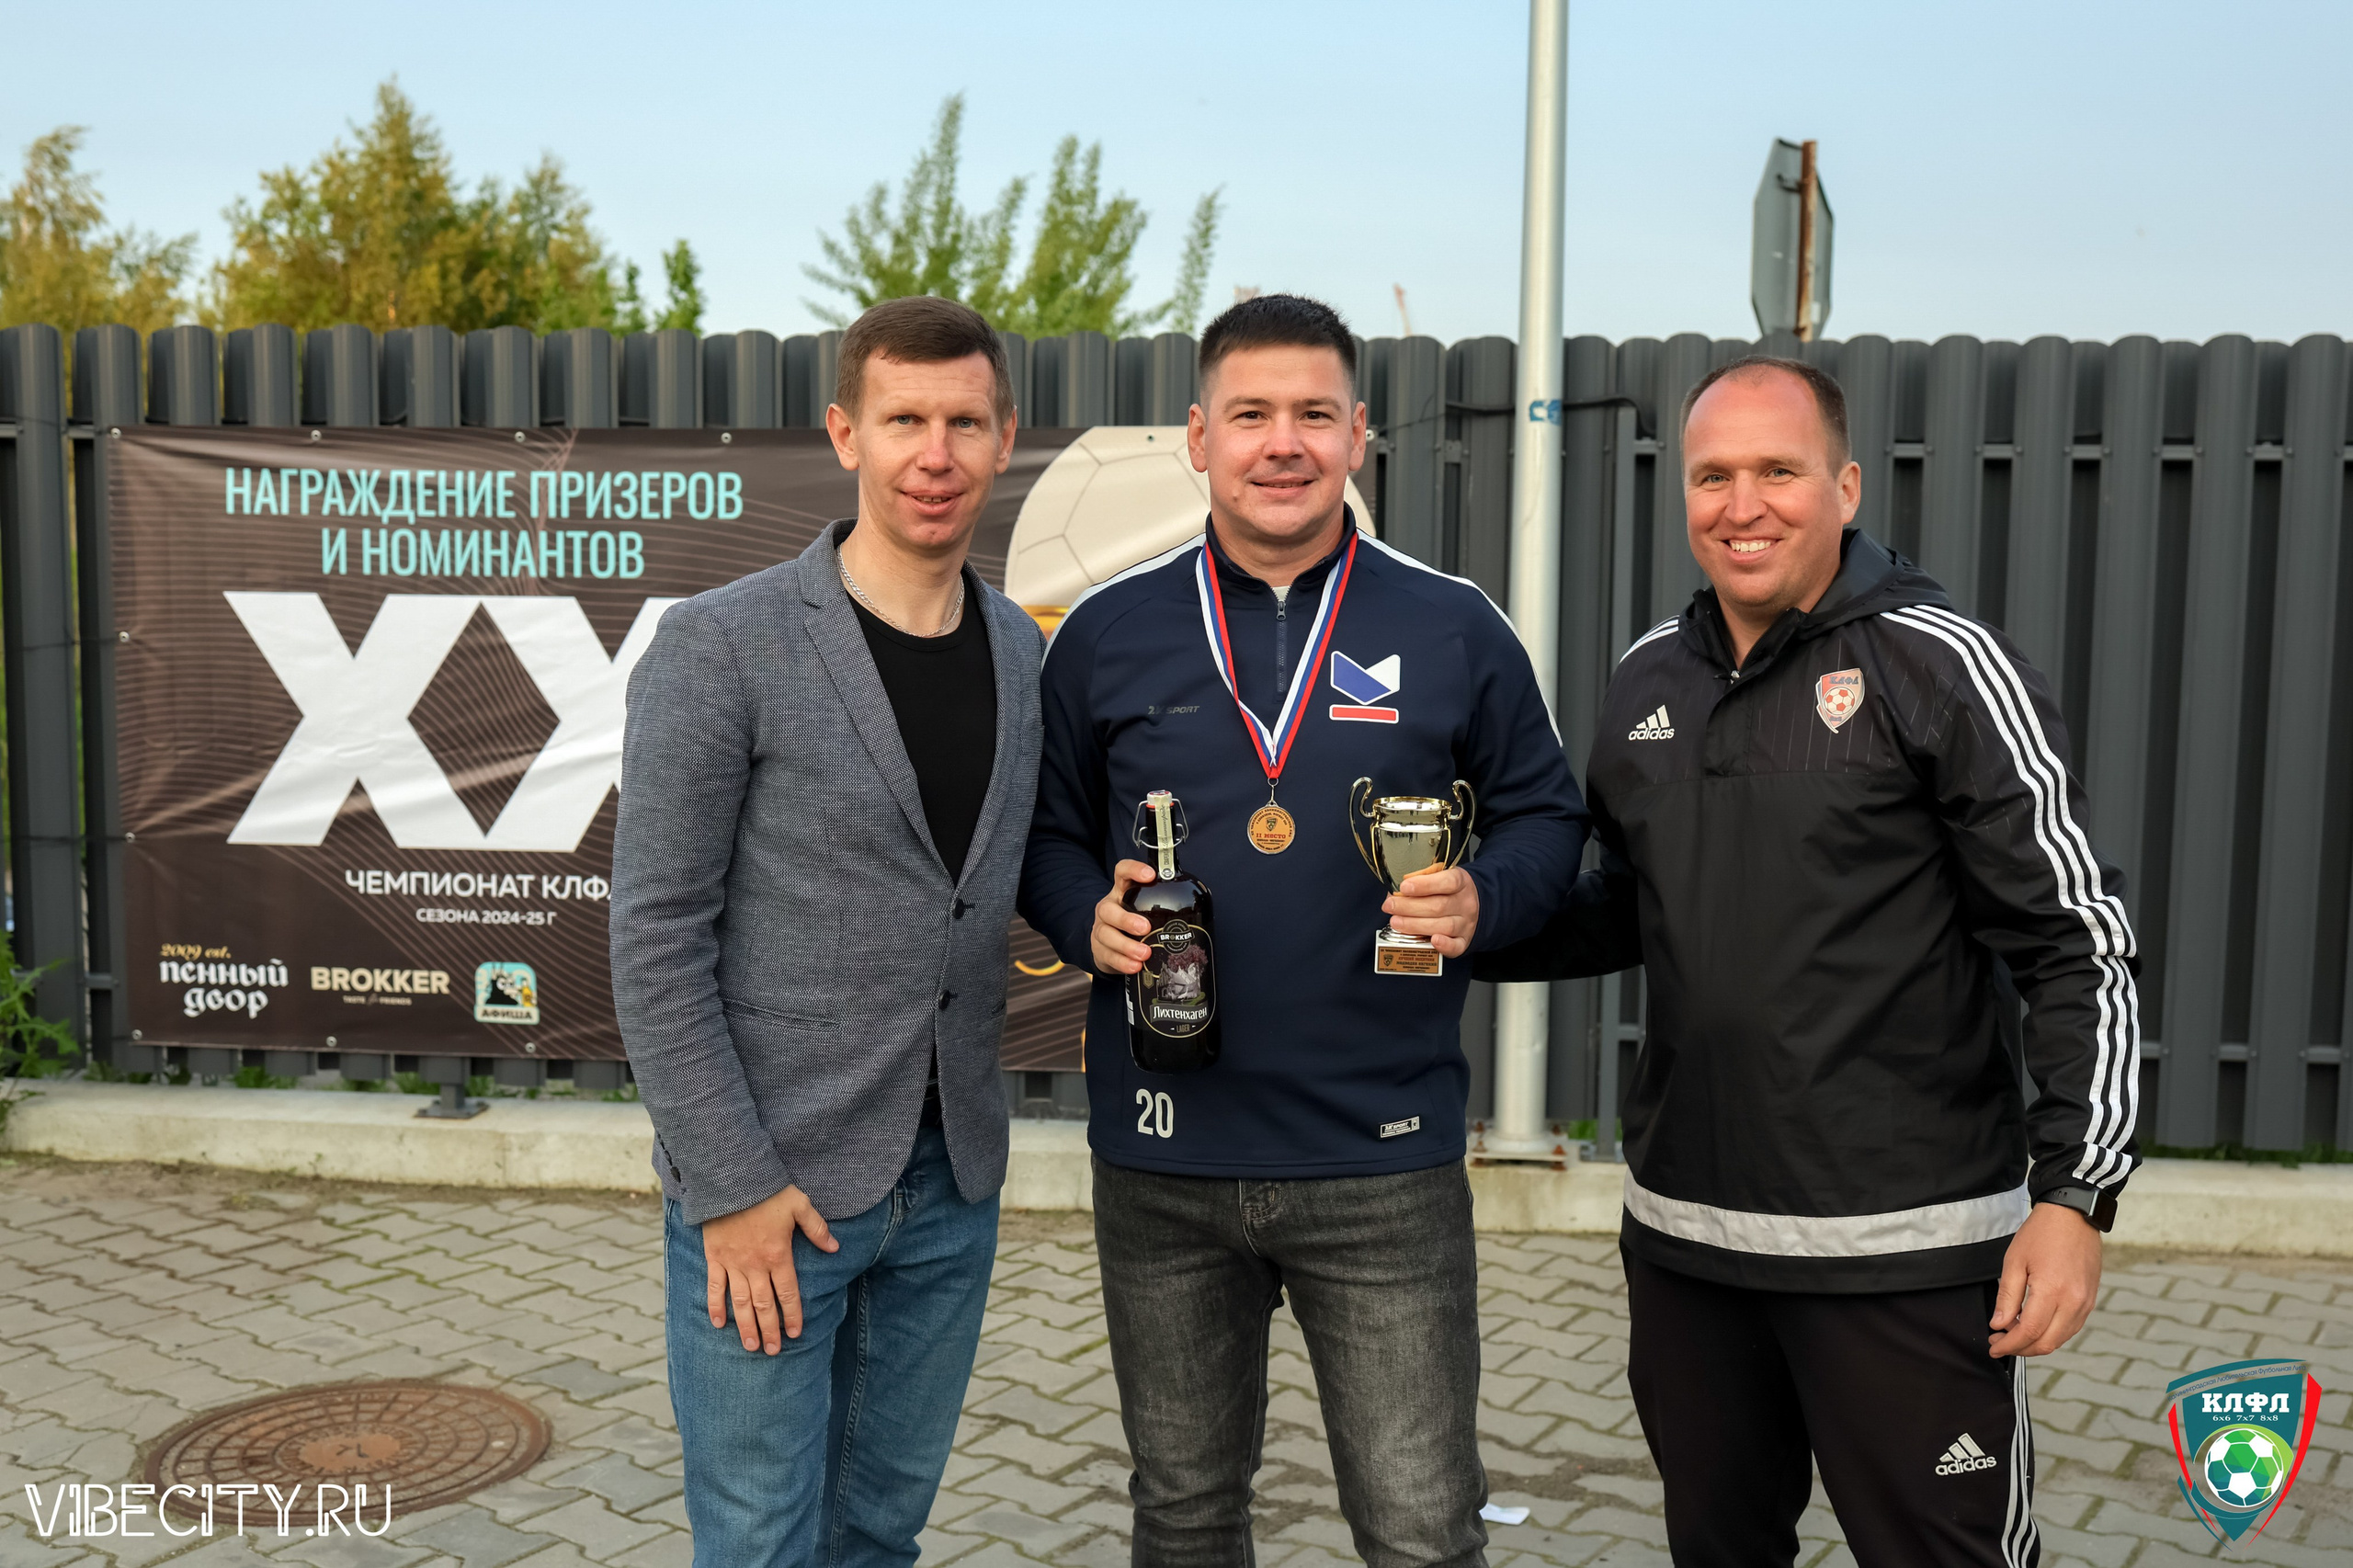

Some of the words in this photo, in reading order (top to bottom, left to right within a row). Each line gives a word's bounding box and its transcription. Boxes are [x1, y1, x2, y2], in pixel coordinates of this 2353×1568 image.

[225, 467, 517, 526] НАГРАЖДЕНИЕ
[529, 470, 744, 521] ПРИЗЕРОВ
[321, 527, 348, 575] И
[361, 528, 645, 580] НОМИНАНТОВ
[1165, 705, 1200, 714] SPORT
[1628, 726, 1676, 741] adidas
[345, 869, 536, 899] ЧЕМПИОНАТ
[541, 873, 611, 902] КЛФ
[415, 907, 481, 923] СЕЗОНА
[482, 909, 545, 926] 2024-25
[160, 943, 202, 960] 2009
[204, 946, 232, 959] est.
[311, 966, 450, 994] BROKKER
[184, 987, 269, 1019] двор
[379, 995, 412, 1006] FRIENDS
[481, 1008, 533, 1020] АФИША
[1154, 1006, 1208, 1020] Лихтенхаген
[1176, 1024, 1190, 1033] LAGER
[1135, 1088, 1174, 1139] 20
[1935, 1452, 1997, 1476] adidas
